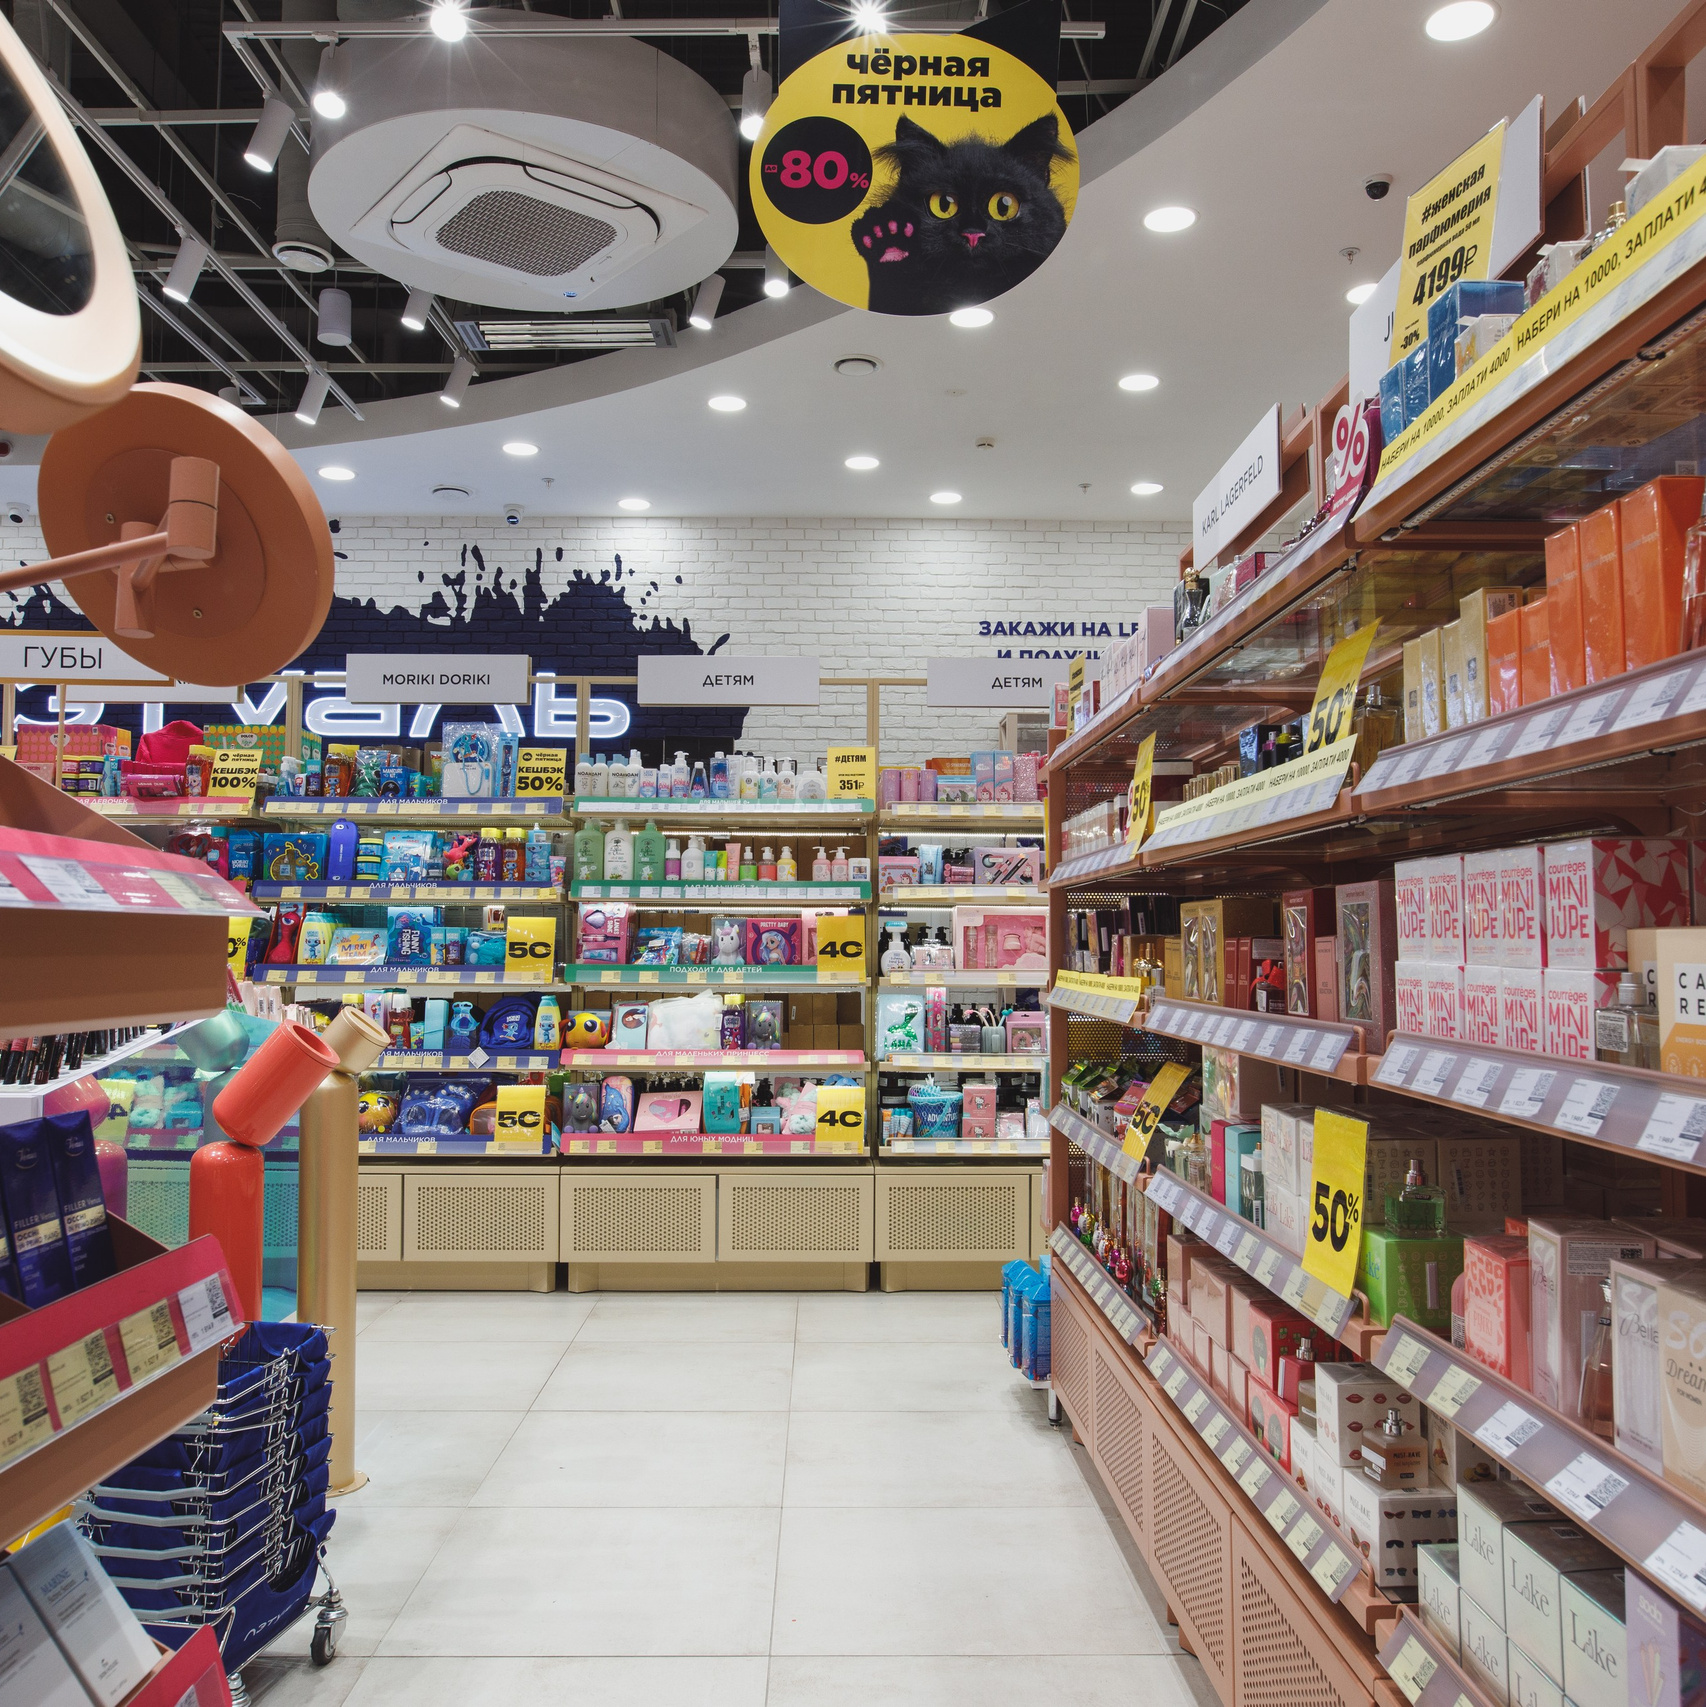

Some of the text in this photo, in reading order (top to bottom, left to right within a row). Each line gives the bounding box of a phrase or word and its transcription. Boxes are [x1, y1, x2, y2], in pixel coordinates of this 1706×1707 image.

[846, 48, 990, 80] чёрная
[831, 83, 1002, 112] пятница
[1421, 163, 1485, 225] #женская
[1408, 185, 1491, 259] парфюмерия
[1517, 186, 1695, 351] НАБЕРИ НА 10000, ЗАПЛАТИ
[1380, 438, 1410, 471] НАБЕРИ
[1410, 431, 1421, 445] НА
[1447, 367, 1488, 413] ЗАПЛАТИ
[1489, 347, 1511, 375] 4000
[1201, 455, 1263, 536] KARL LAGERFELD
[978, 621, 1109, 637] ЗАКАЖИ НА
[24, 646, 102, 669] ГУБЫ
[383, 674, 490, 685] MORIKI DORIKI
[702, 675, 755, 687] ДЕТЯМ
[991, 677, 1043, 689] ДЕТЯМ
[212, 767, 258, 775] КЕШБЭК
[518, 766, 564, 774] КЕШБЭК
[834, 755, 867, 763] #ДЕТЯМ
[1268, 773, 1288, 788] НАБЕРИ
[1310, 753, 1337, 773] ЗАПЛАТИ
[211, 776, 256, 789] 100%
[517, 776, 563, 791] 50%
[1398, 876, 1423, 888] courrèges
[1429, 873, 1456, 886] courrèges
[1467, 869, 1496, 882] courrèges
[1501, 865, 1532, 880] courrèges
[1548, 861, 1586, 877] courrèges
[1398, 887, 1425, 917] MINI
[1430, 885, 1458, 915] MINI
[1468, 881, 1497, 914] MINI
[1502, 879, 1534, 913] MINI
[1550, 874, 1588, 912] MINI
[1400, 911, 1426, 939] JUPE
[1431, 910, 1459, 939] JUPE
[1468, 908, 1498, 939] JUPE
[1502, 907, 1535, 939] JUPE
[1550, 904, 1589, 940] JUPE
[401, 928, 411, 956] FISHING
[411, 929, 420, 954] FUNNY
[1398, 977, 1422, 989] courrèges
[1427, 979, 1455, 993] courrèges
[1466, 982, 1497, 996] courrèges
[1504, 985, 1536, 1000] courrèges
[1548, 988, 1587, 1004] courrèges
[1398, 988, 1423, 1016] MINI
[1428, 991, 1455, 1021] MINI
[1467, 994, 1498, 1027] MINI
[1504, 998, 1537, 1033] MINI
[1549, 1002, 1588, 1040] MINI
[64, 1200, 87, 1213] FILLER
[66, 1212, 86, 1225] OCCHI
[1312, 1180, 1360, 1252] 50%
[14, 1214, 39, 1230] FILLER
[17, 1228, 40, 1242] OCCHI
[1463, 1512, 1494, 1565] Like
[1422, 1572, 1451, 1625] Like
[1510, 1556, 1550, 1617] Like
[1465, 1618, 1499, 1678] Like
[1569, 1608, 1618, 1679] Like
